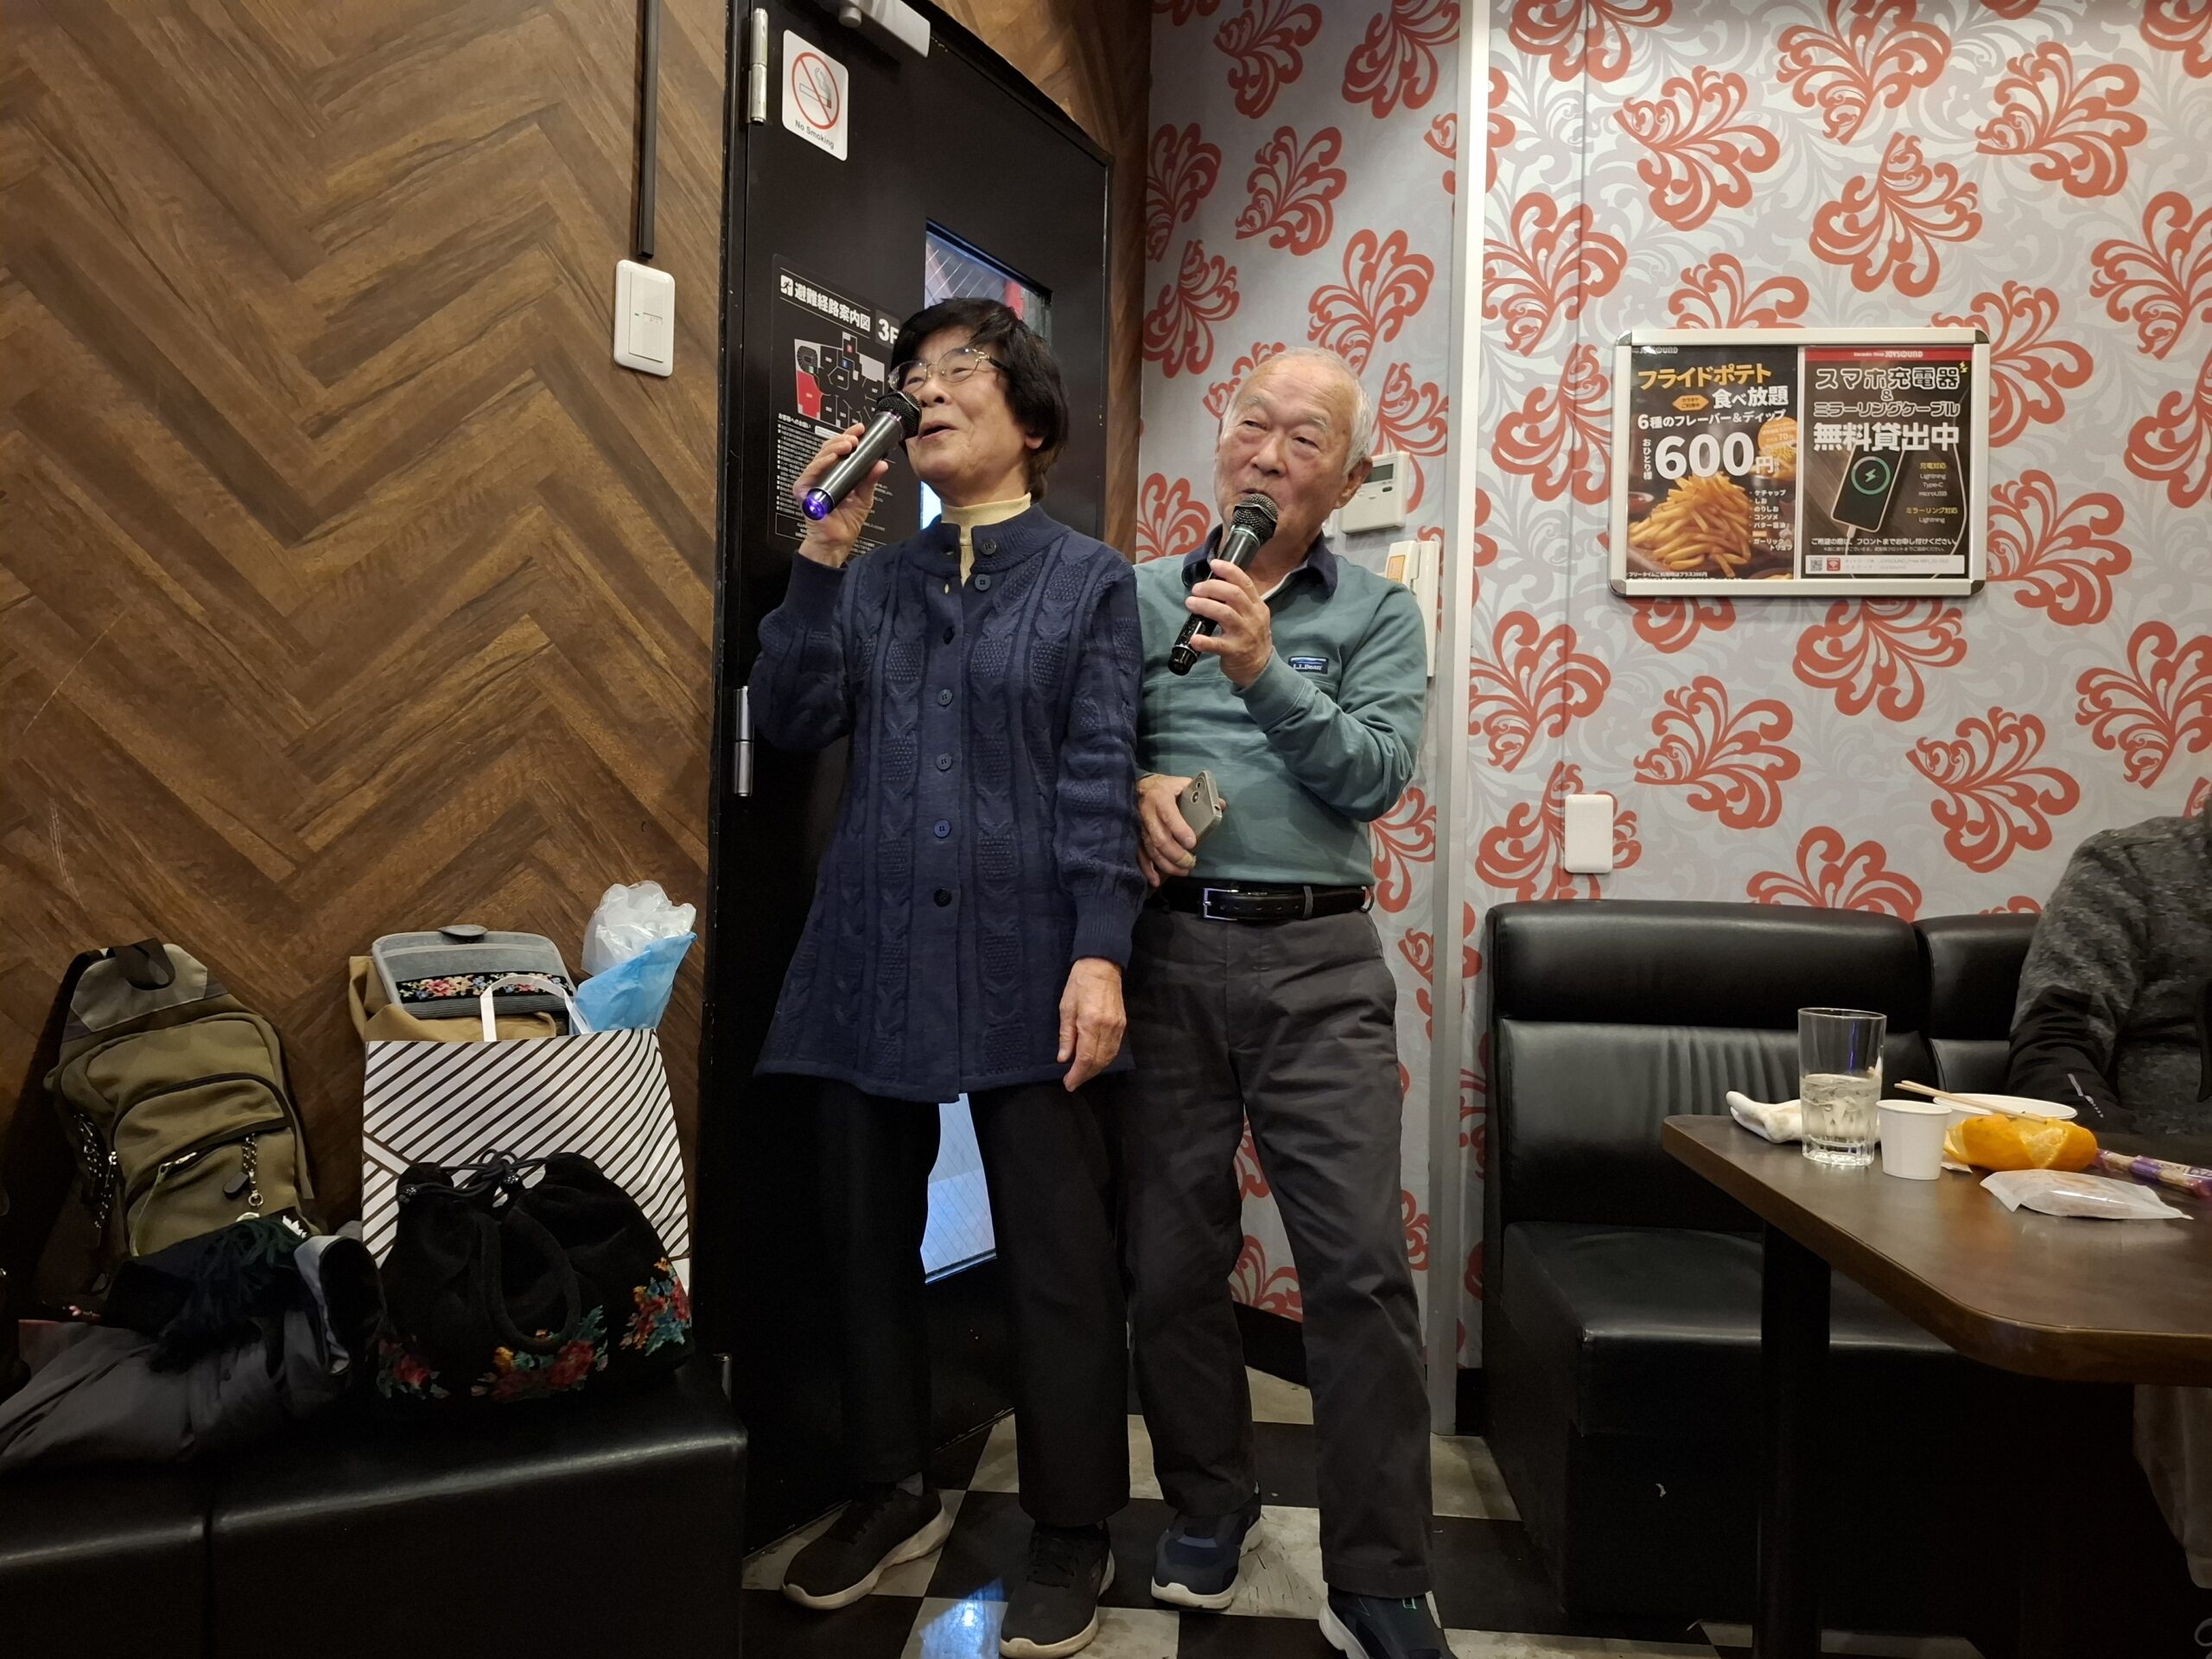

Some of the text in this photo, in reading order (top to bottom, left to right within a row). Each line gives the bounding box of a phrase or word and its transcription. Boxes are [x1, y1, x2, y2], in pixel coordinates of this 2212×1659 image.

[795, 119, 835, 149] No Smoking
[794, 281, 871, 332] 避難経路案内図
[877, 317, 899, 345] 3F
[1637, 363, 1771, 391] フライドポテト
[1815, 366, 1960, 390] スマホ充電器
[1712, 385, 1789, 410] 食べ放題
[1814, 401, 1960, 417] ミラーリングケーブル
[1880, 389, 1894, 401] &
[1813, 422, 1960, 452] 無料貸出中
[1642, 438, 1653, 480] おひとり様
